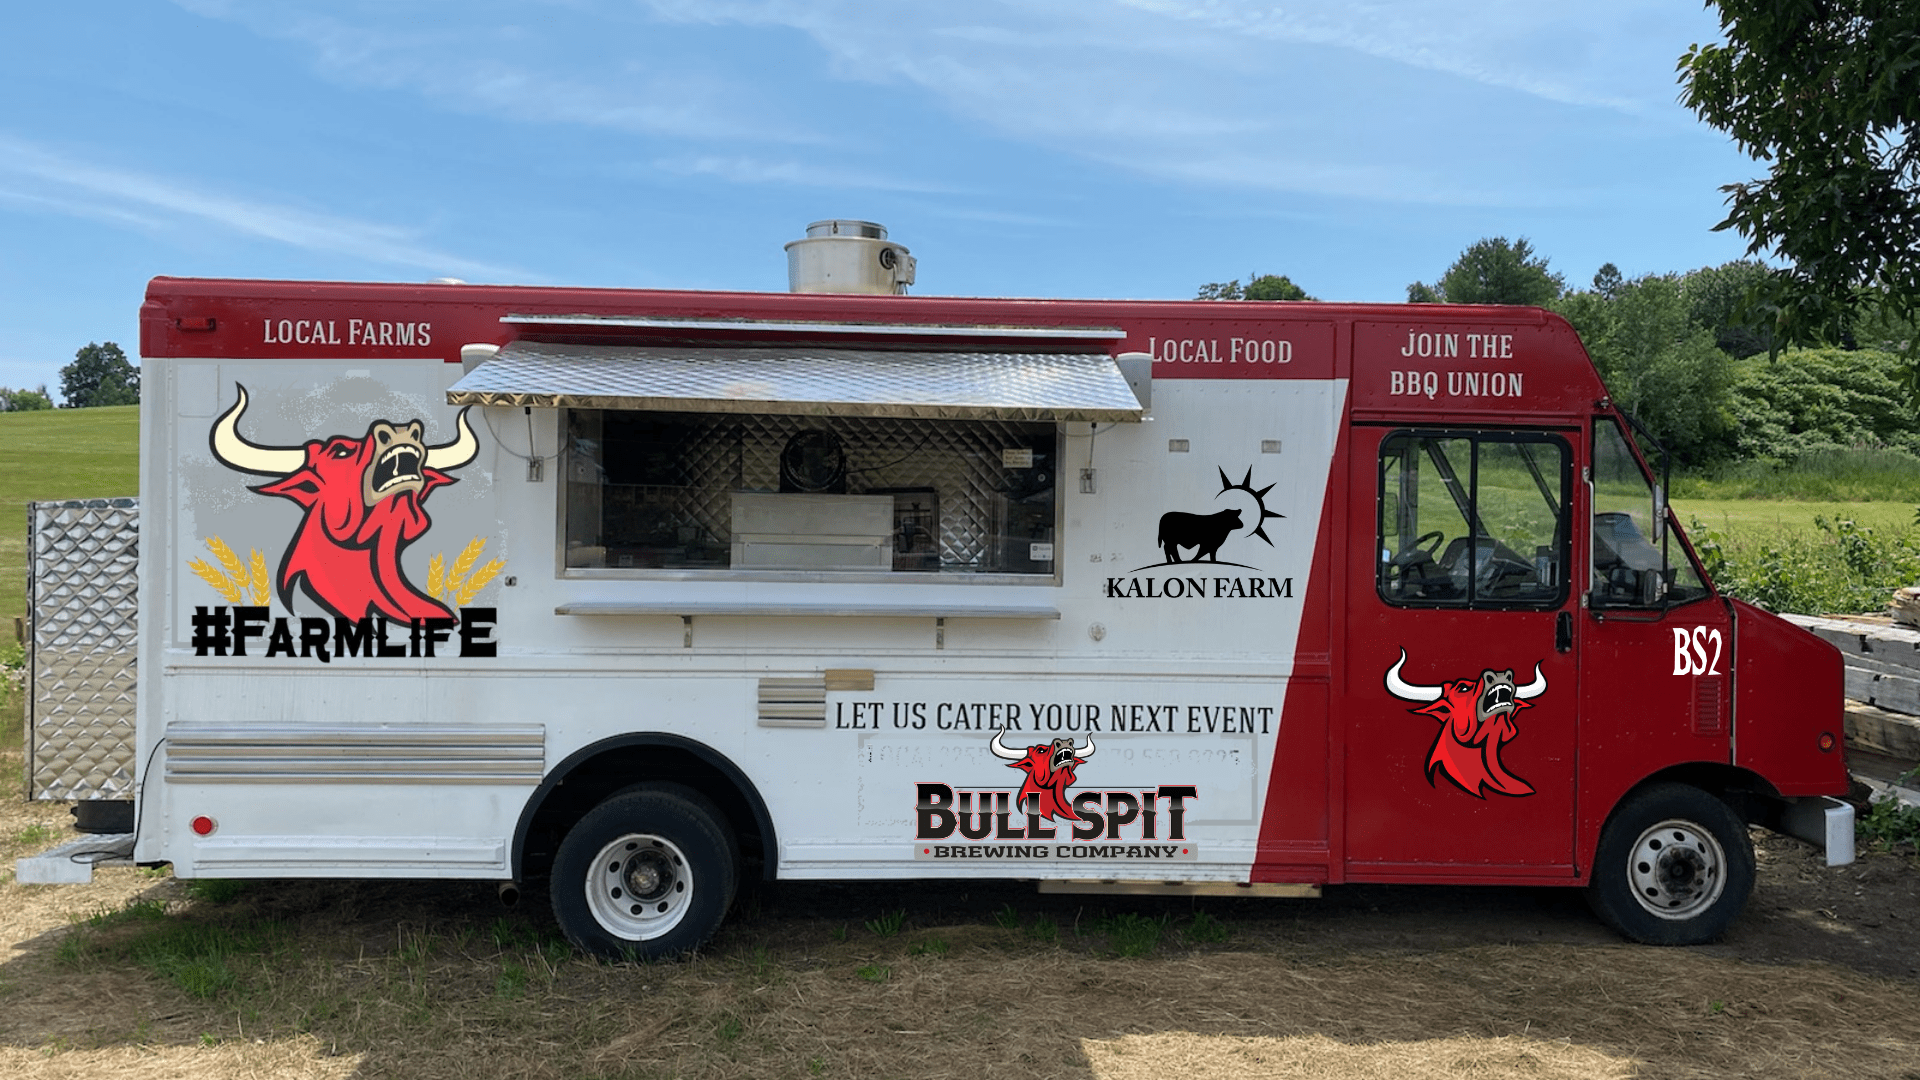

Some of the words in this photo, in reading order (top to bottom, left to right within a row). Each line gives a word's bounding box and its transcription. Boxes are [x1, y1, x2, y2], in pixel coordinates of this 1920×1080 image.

[264, 319, 341, 345] LOCAL
[348, 319, 432, 346] FARMS
[1401, 329, 1459, 358] JOIN
[1466, 334, 1513, 359] THE
[1149, 337, 1223, 363] LOCAL
[1230, 337, 1292, 364] FOOD
[1390, 371, 1438, 400] BBQ
[1447, 371, 1523, 397] UNION
[1106, 577, 1208, 598] KALON
[1213, 577, 1293, 598] FARM
[191, 606, 498, 663] #FARMLIFE
[1672, 625, 1723, 676] BS2
[836, 702, 884, 729] LET
[892, 702, 926, 730] US
[937, 703, 1022, 731] CATER
[1029, 703, 1101, 732] YOUR
[1110, 705, 1179, 732] NEXT
[1187, 706, 1273, 734] EVENT
[914, 782, 1057, 841] BULL
[1071, 785, 1198, 841] SPIT
[933, 845, 1049, 859] BREWING
[1056, 845, 1179, 859] COMPANY
